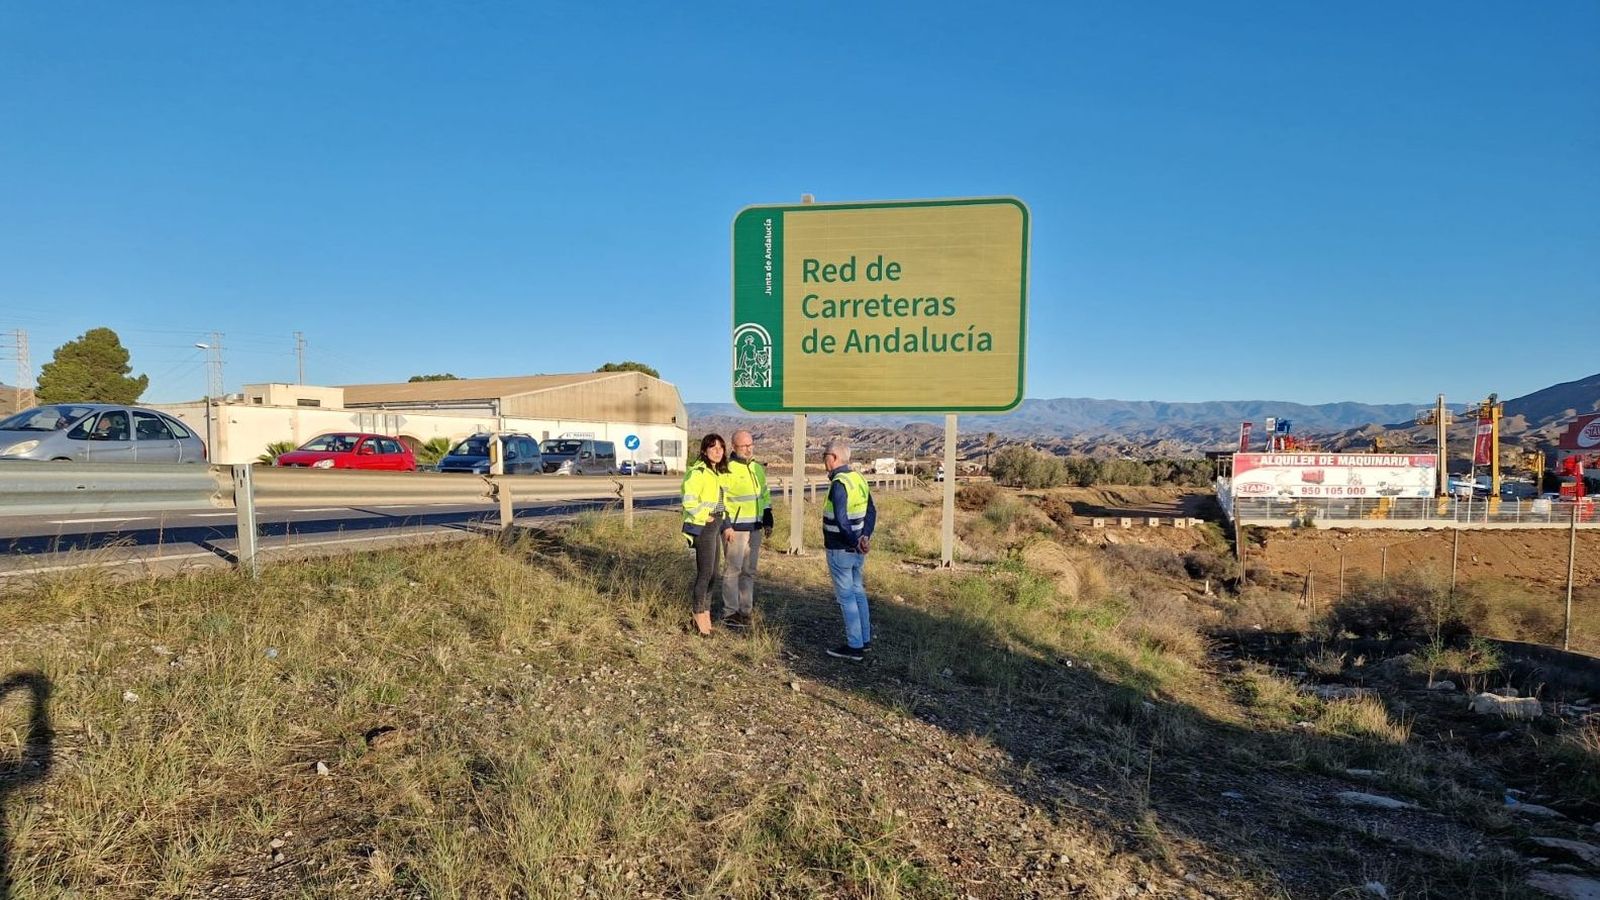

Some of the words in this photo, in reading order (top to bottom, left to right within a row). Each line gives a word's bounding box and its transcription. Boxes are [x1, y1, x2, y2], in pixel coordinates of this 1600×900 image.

[763, 218, 772, 260] Andalucía
[764, 260, 772, 271] de
[802, 255, 857, 283] Red
[866, 254, 902, 282] de
[764, 272, 772, 296] Junta
[801, 293, 957, 319] Carreteras
[801, 327, 837, 354] de
[843, 324, 993, 354] Andalucía
[1261, 455, 1315, 465] ALQUILER
[1321, 455, 1334, 465] DE
[1337, 456, 1410, 466] MAQUINARIA
[1238, 483, 1272, 493] STAND
[1301, 487, 1321, 495] 950
[1325, 487, 1343, 495] 105
[1347, 487, 1366, 495] 000
